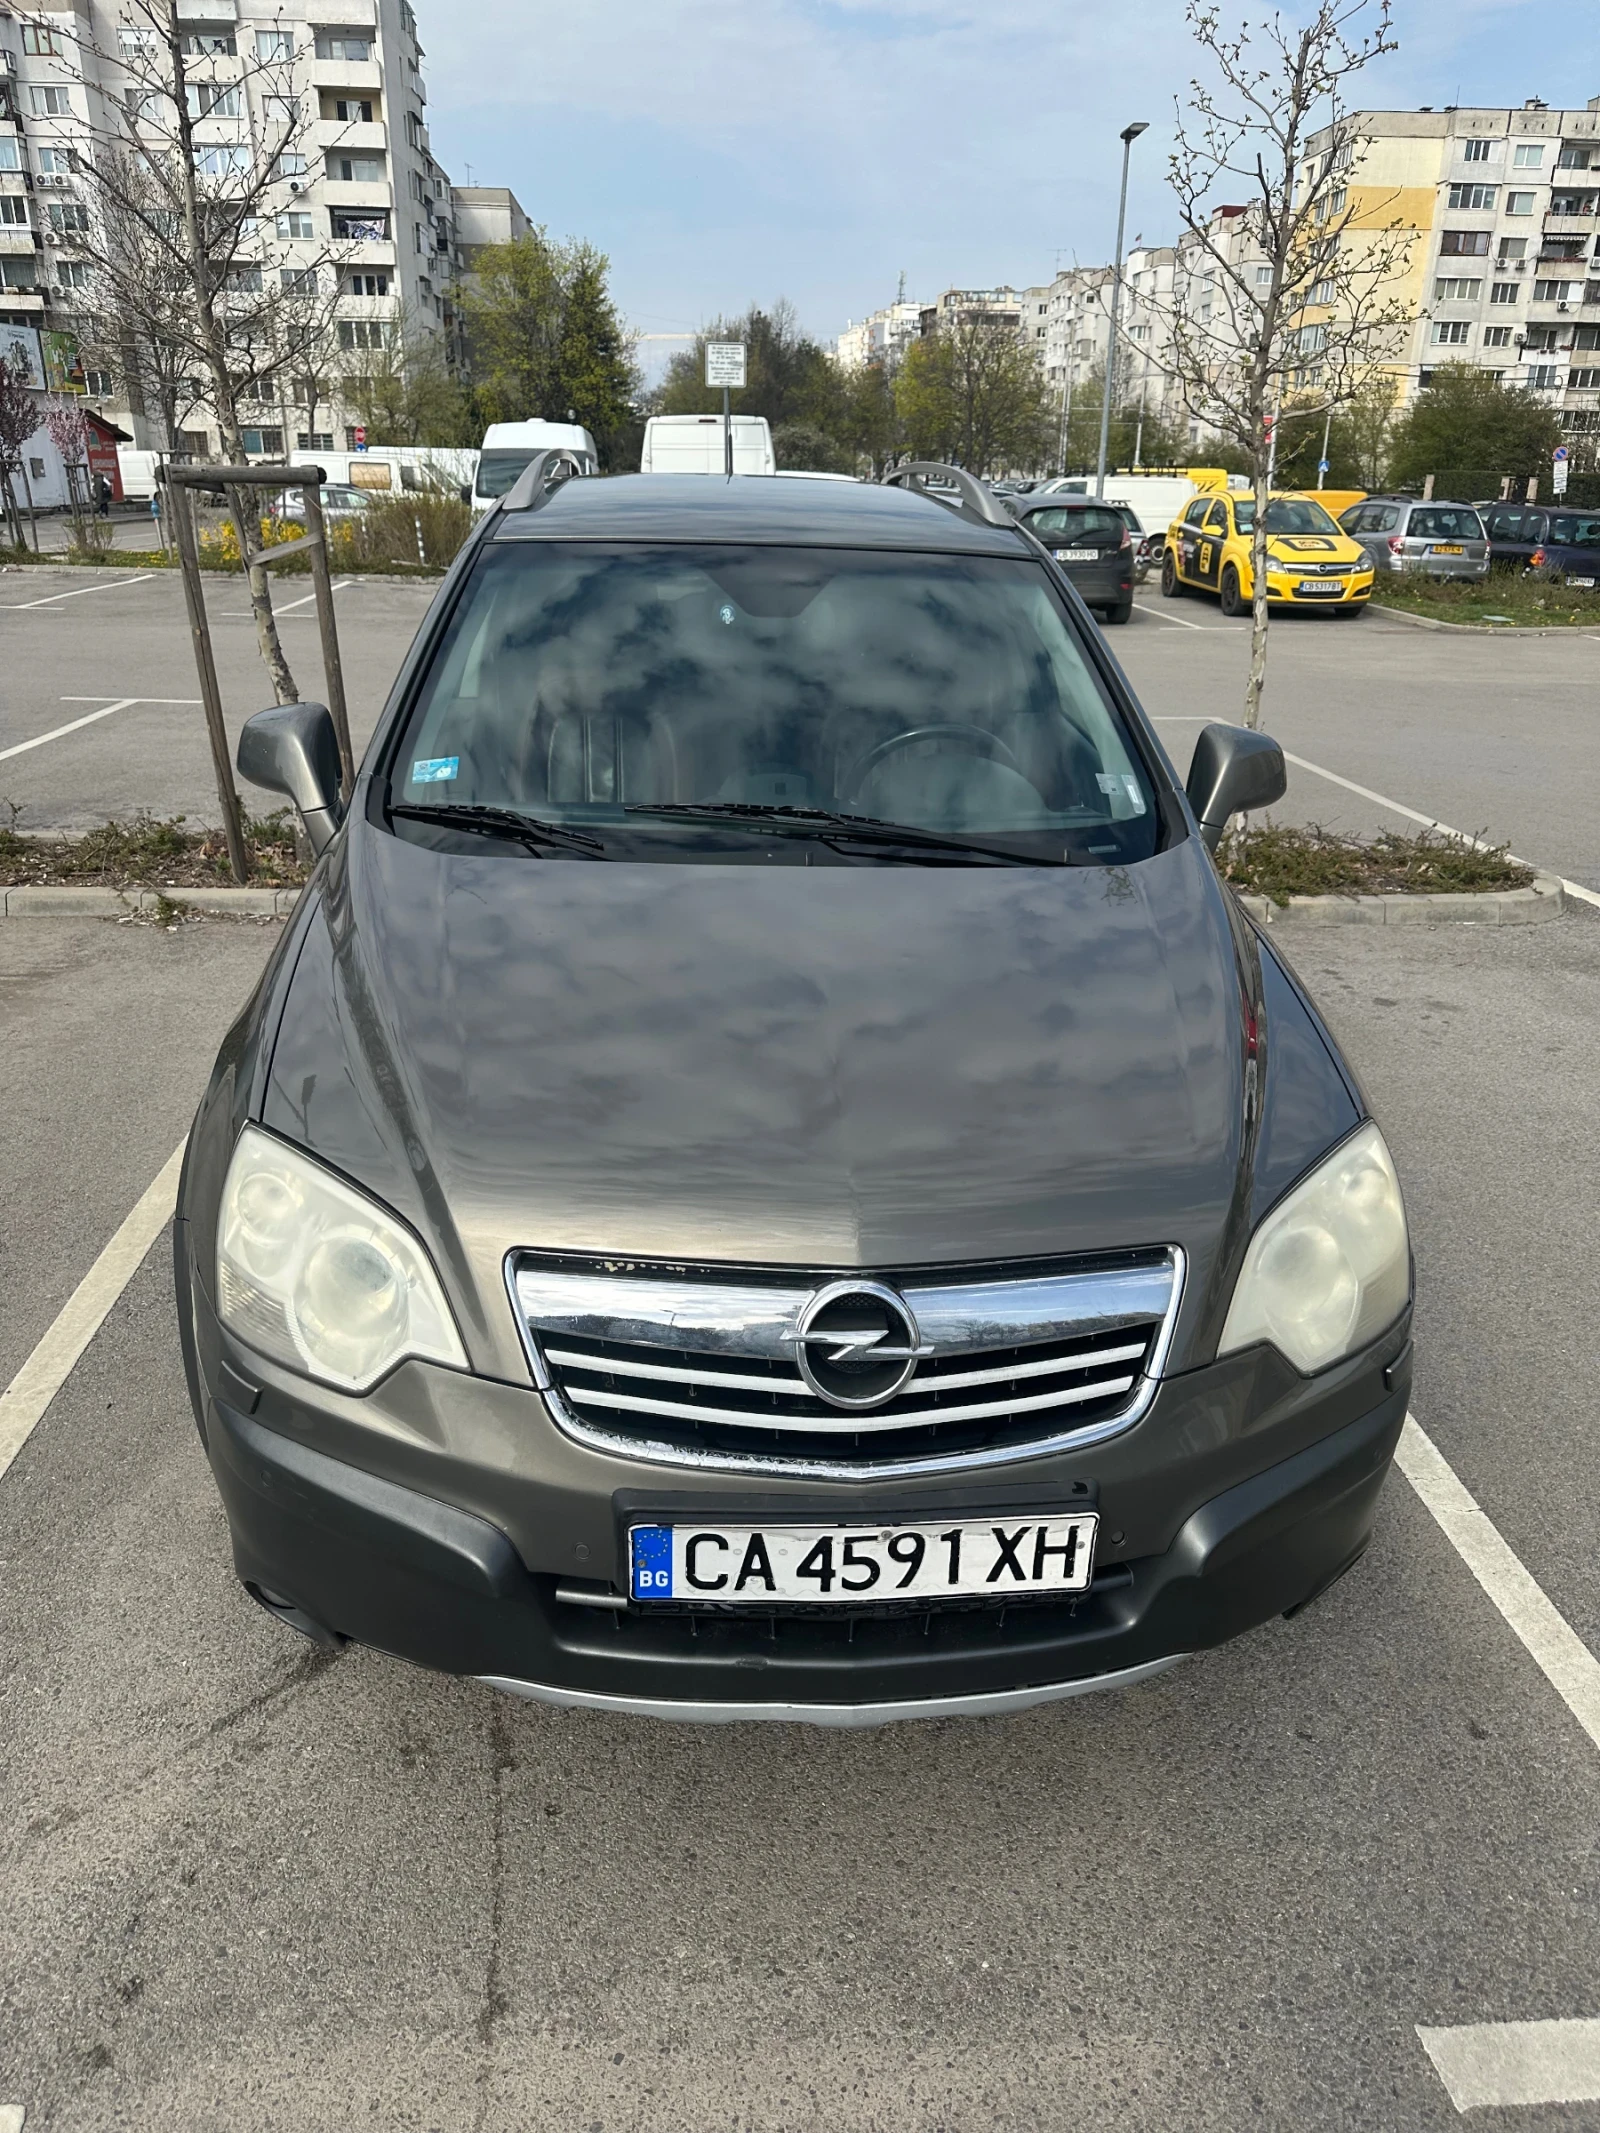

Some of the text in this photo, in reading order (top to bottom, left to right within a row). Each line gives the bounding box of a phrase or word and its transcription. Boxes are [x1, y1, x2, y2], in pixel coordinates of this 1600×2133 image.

[639, 1571, 668, 1588] BG
[685, 1525, 1080, 1593] CA 4591 XH
